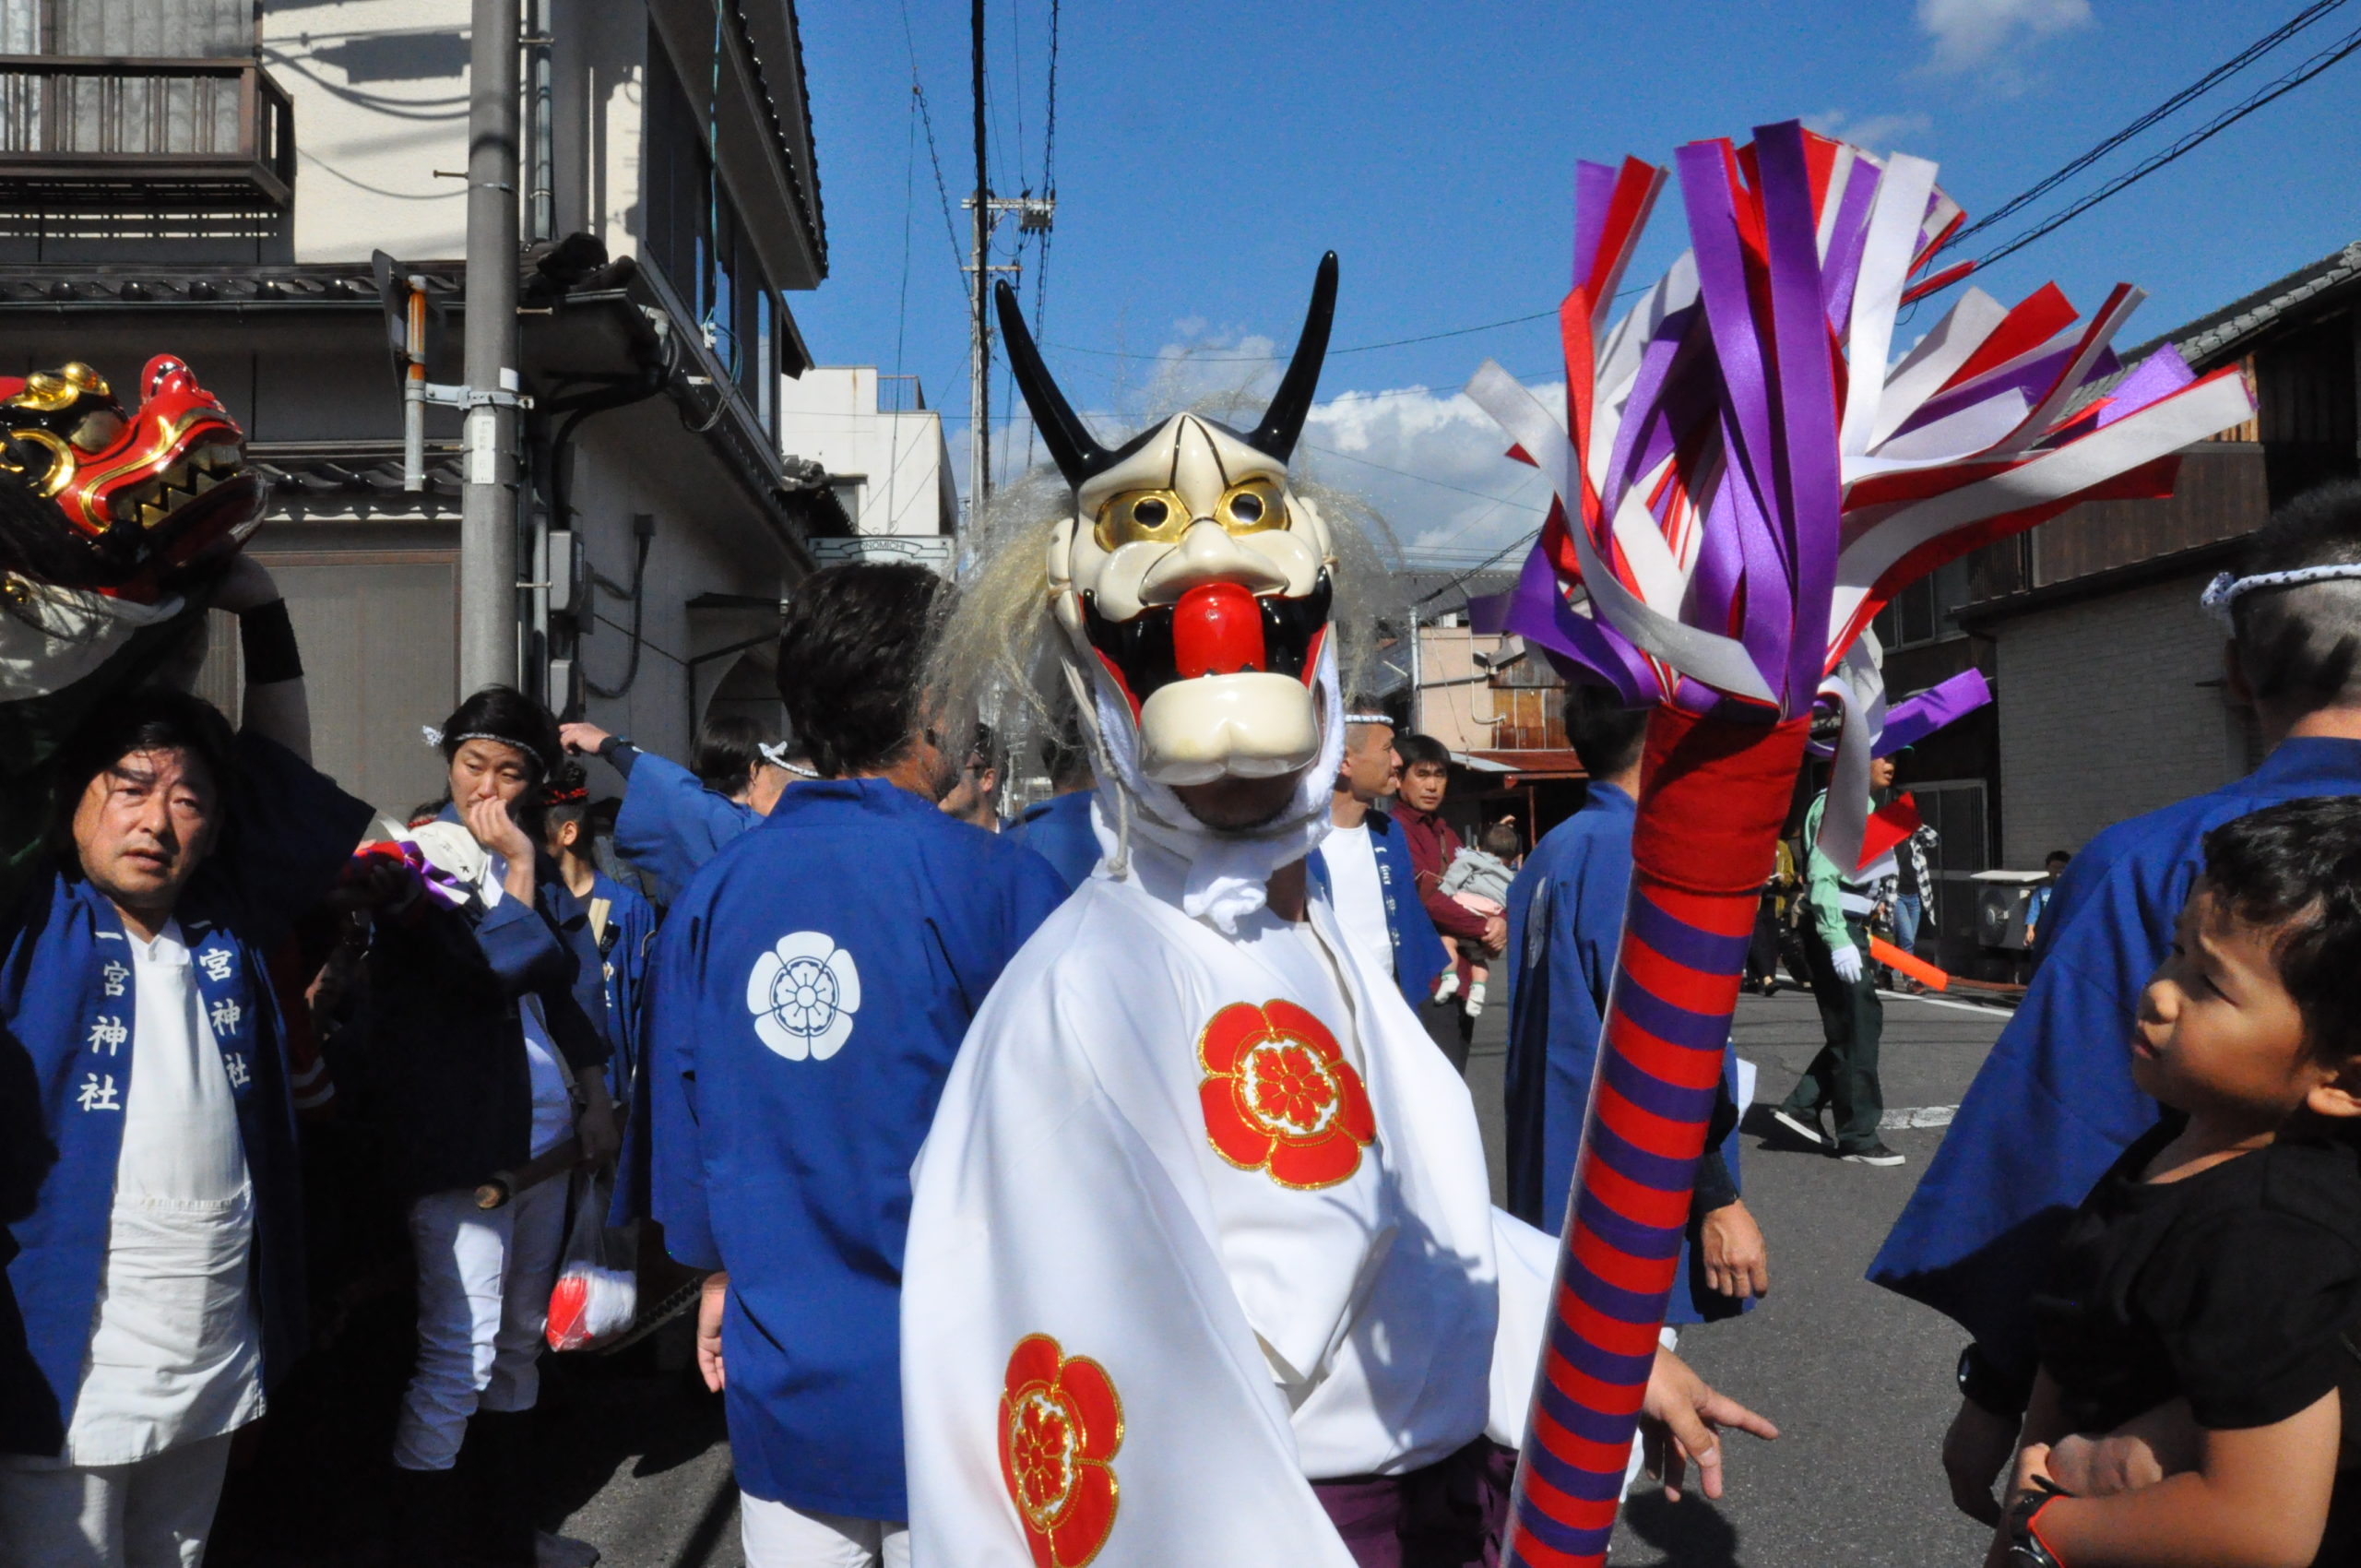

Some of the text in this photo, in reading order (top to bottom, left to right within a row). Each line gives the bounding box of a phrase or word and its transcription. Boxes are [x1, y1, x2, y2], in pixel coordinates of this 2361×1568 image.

[77, 931, 130, 1112] 一宮神社
[188, 920, 251, 1089] 一宮神社
